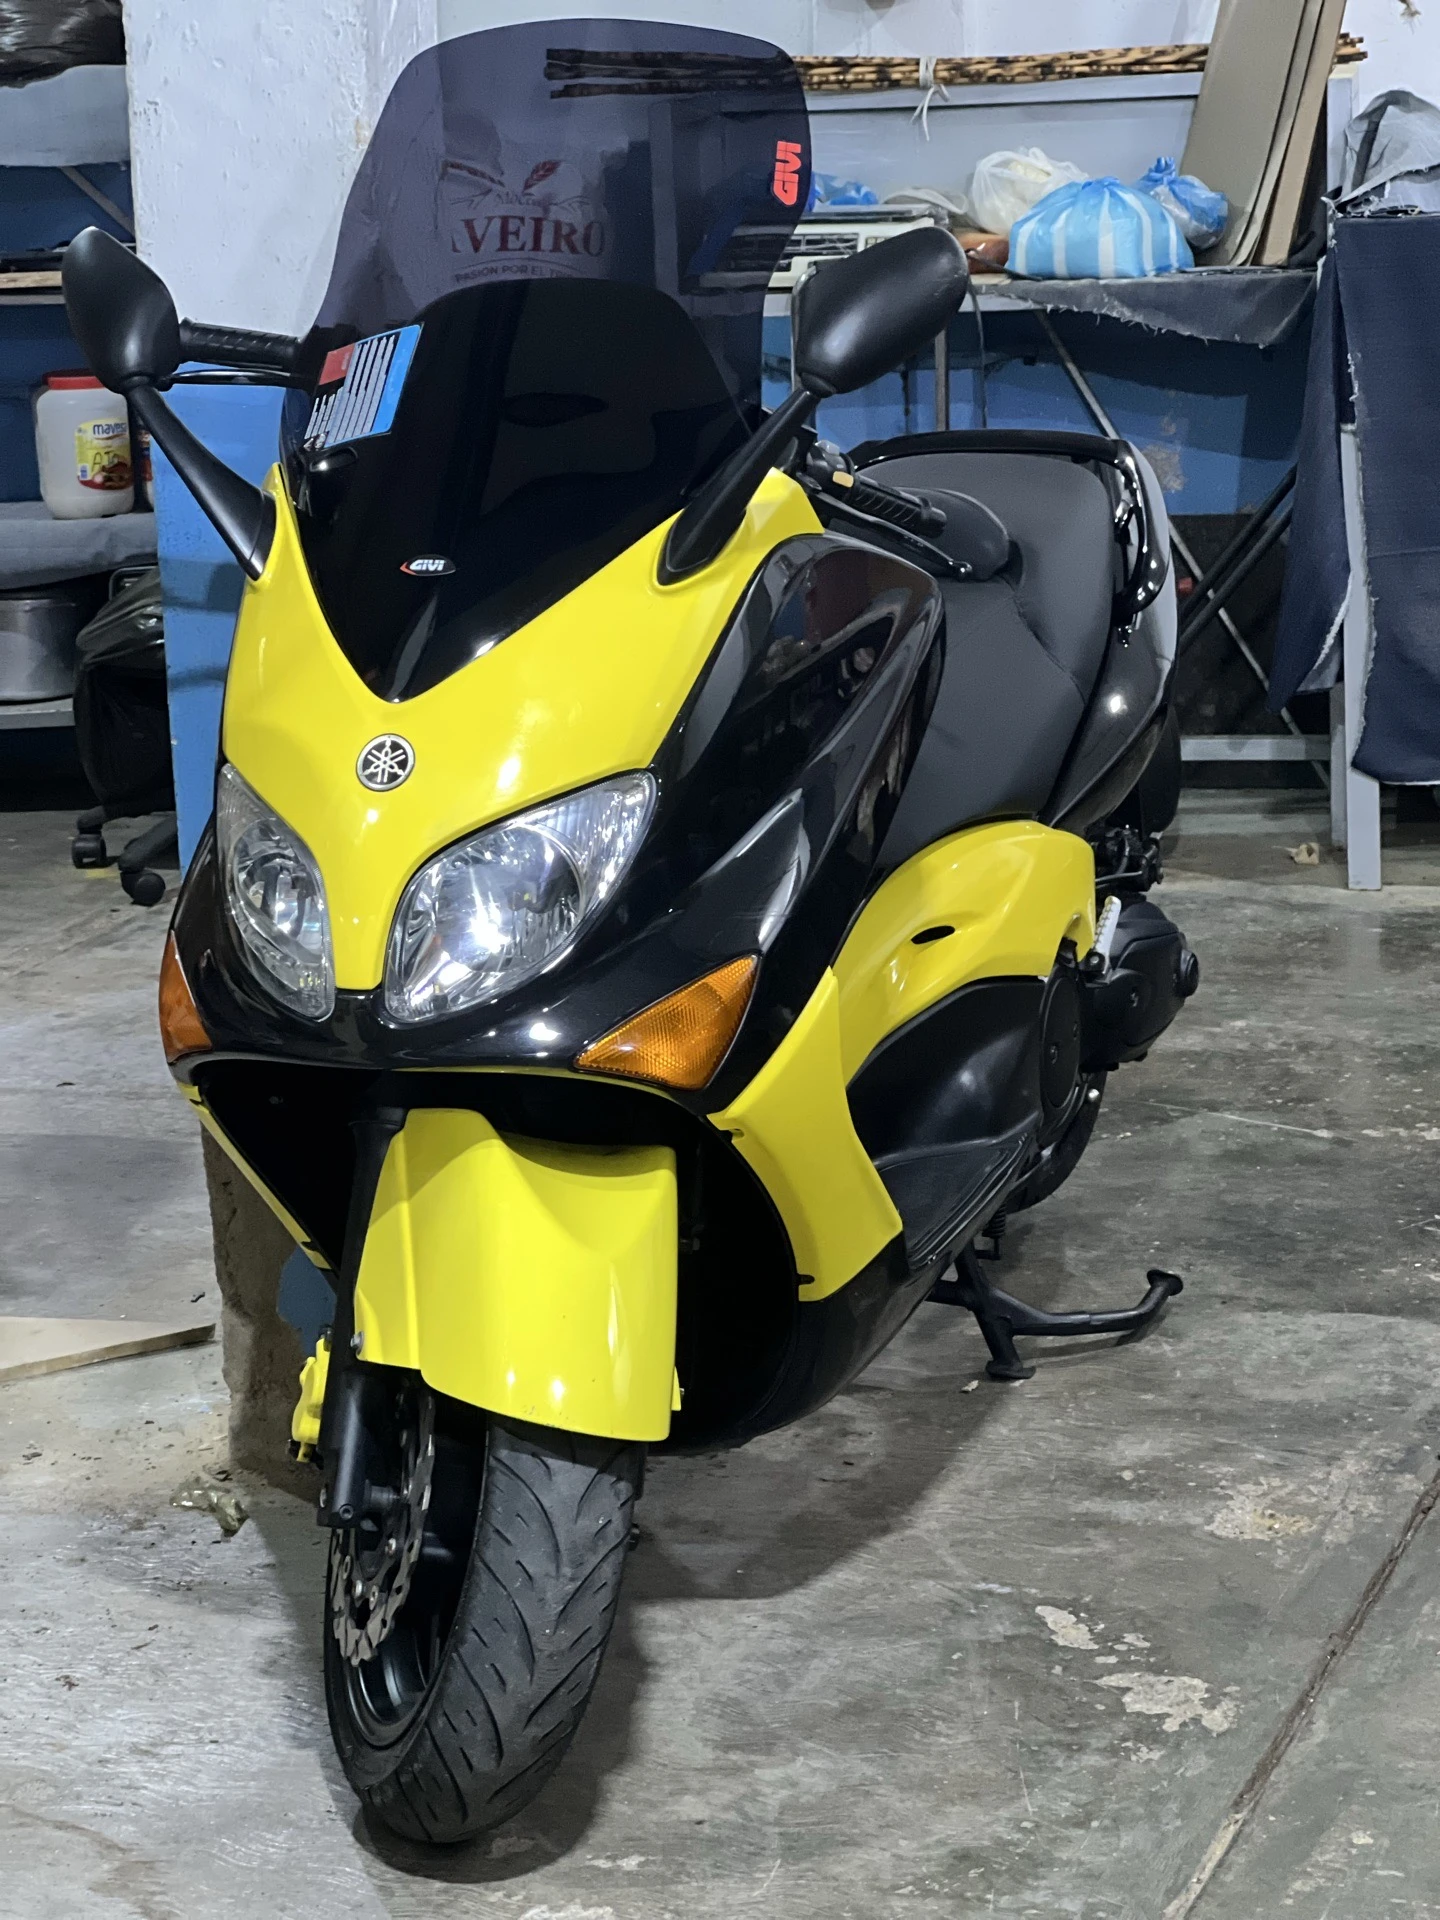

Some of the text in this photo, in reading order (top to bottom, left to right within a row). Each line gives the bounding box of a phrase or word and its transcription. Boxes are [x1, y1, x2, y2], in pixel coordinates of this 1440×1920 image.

[773, 140, 802, 206] GIVI
[501, 264, 528, 275] POR
[531, 265, 546, 276] EL
[409, 559, 446, 571] GIVI
